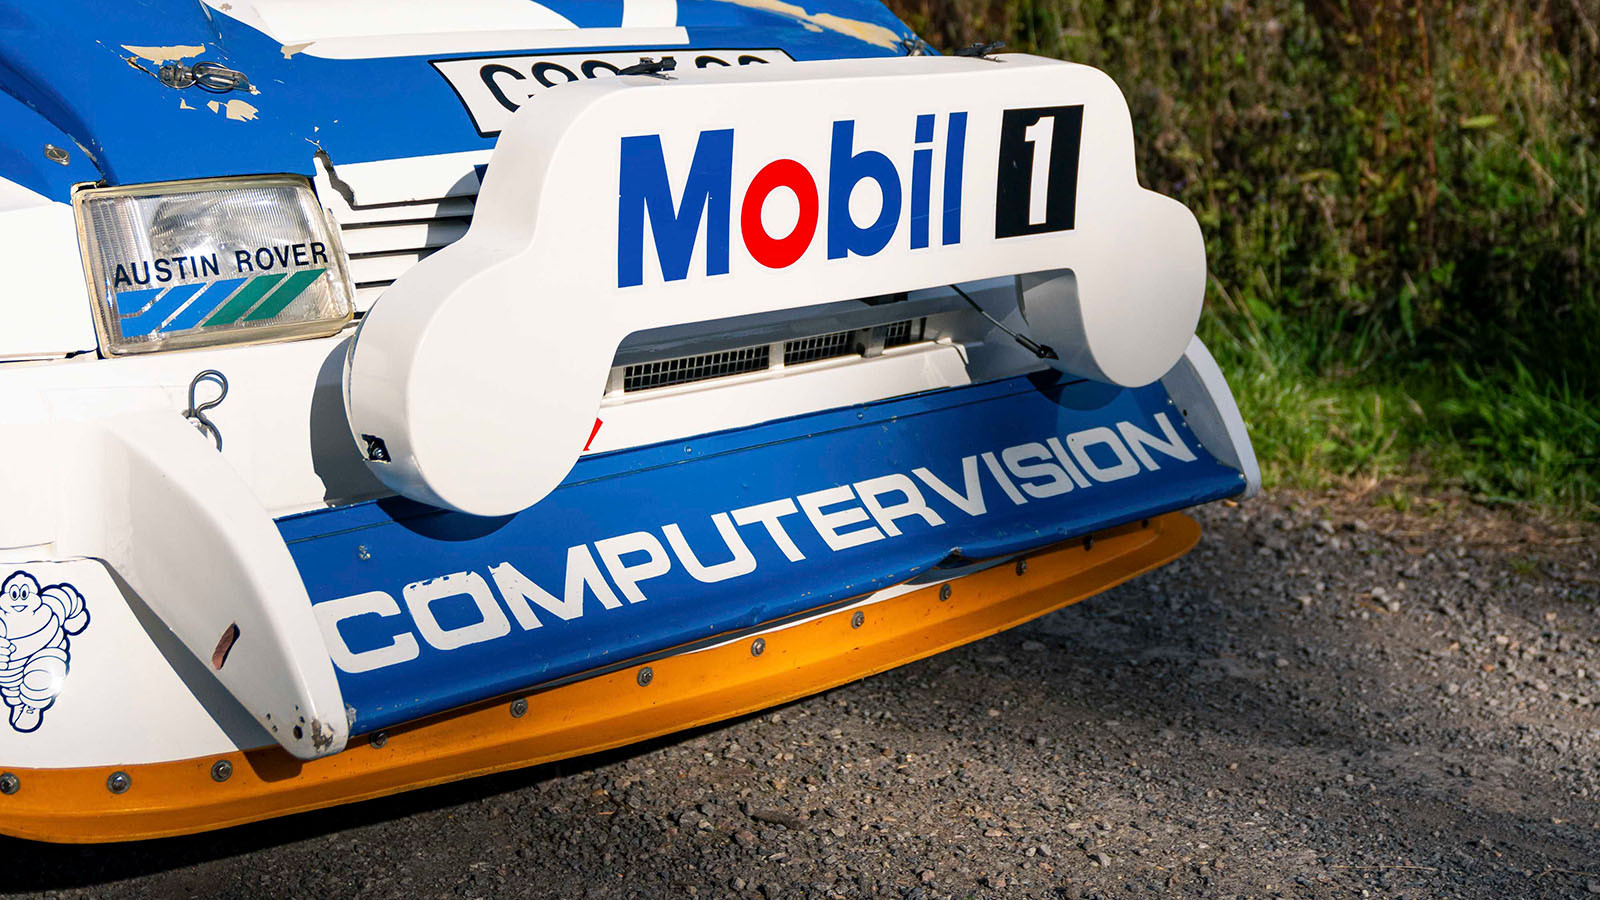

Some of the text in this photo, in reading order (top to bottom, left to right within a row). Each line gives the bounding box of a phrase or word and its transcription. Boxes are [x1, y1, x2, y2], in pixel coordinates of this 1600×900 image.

[114, 242, 328, 287] AUSTIN ROVER
[617, 111, 1054, 288] Mobil 1
[312, 412, 1198, 673] COMPUTERVISION
